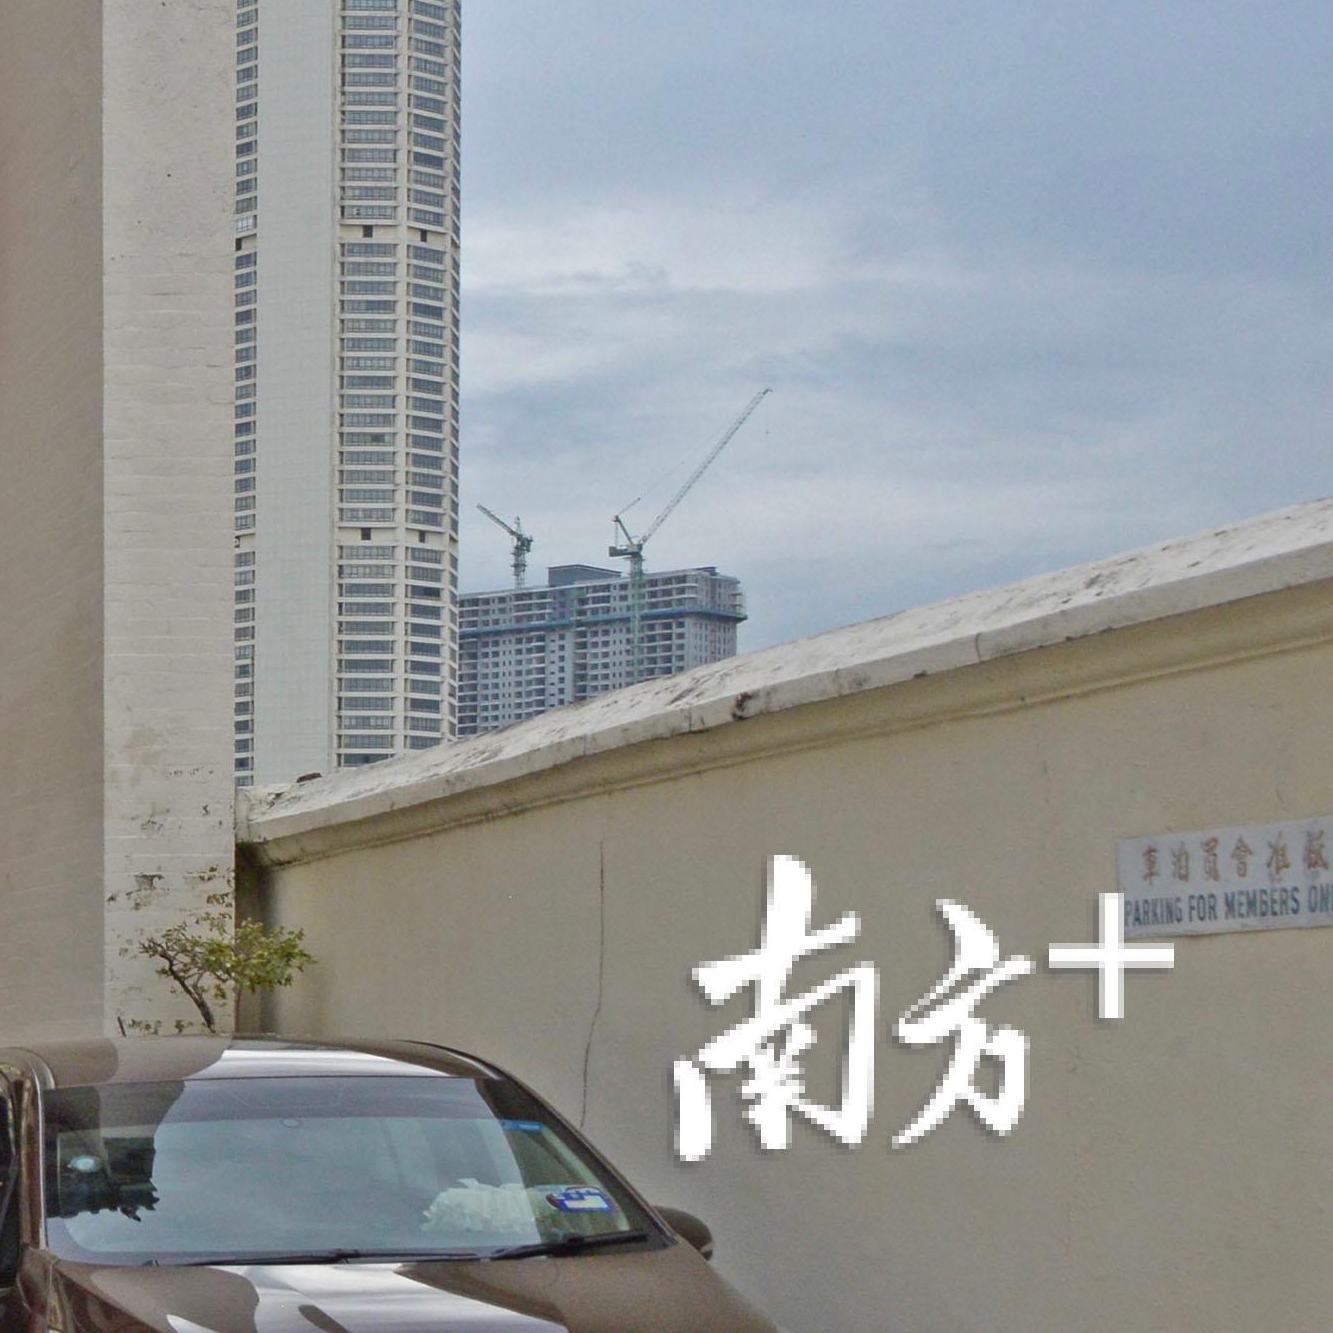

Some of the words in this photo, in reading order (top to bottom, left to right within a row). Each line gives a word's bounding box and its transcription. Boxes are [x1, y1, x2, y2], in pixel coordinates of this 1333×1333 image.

[1125, 897, 1183, 927] PARKING
[1188, 893, 1218, 923] FOR
[1225, 886, 1300, 920] MEMBERS
[1308, 882, 1333, 913] ON
